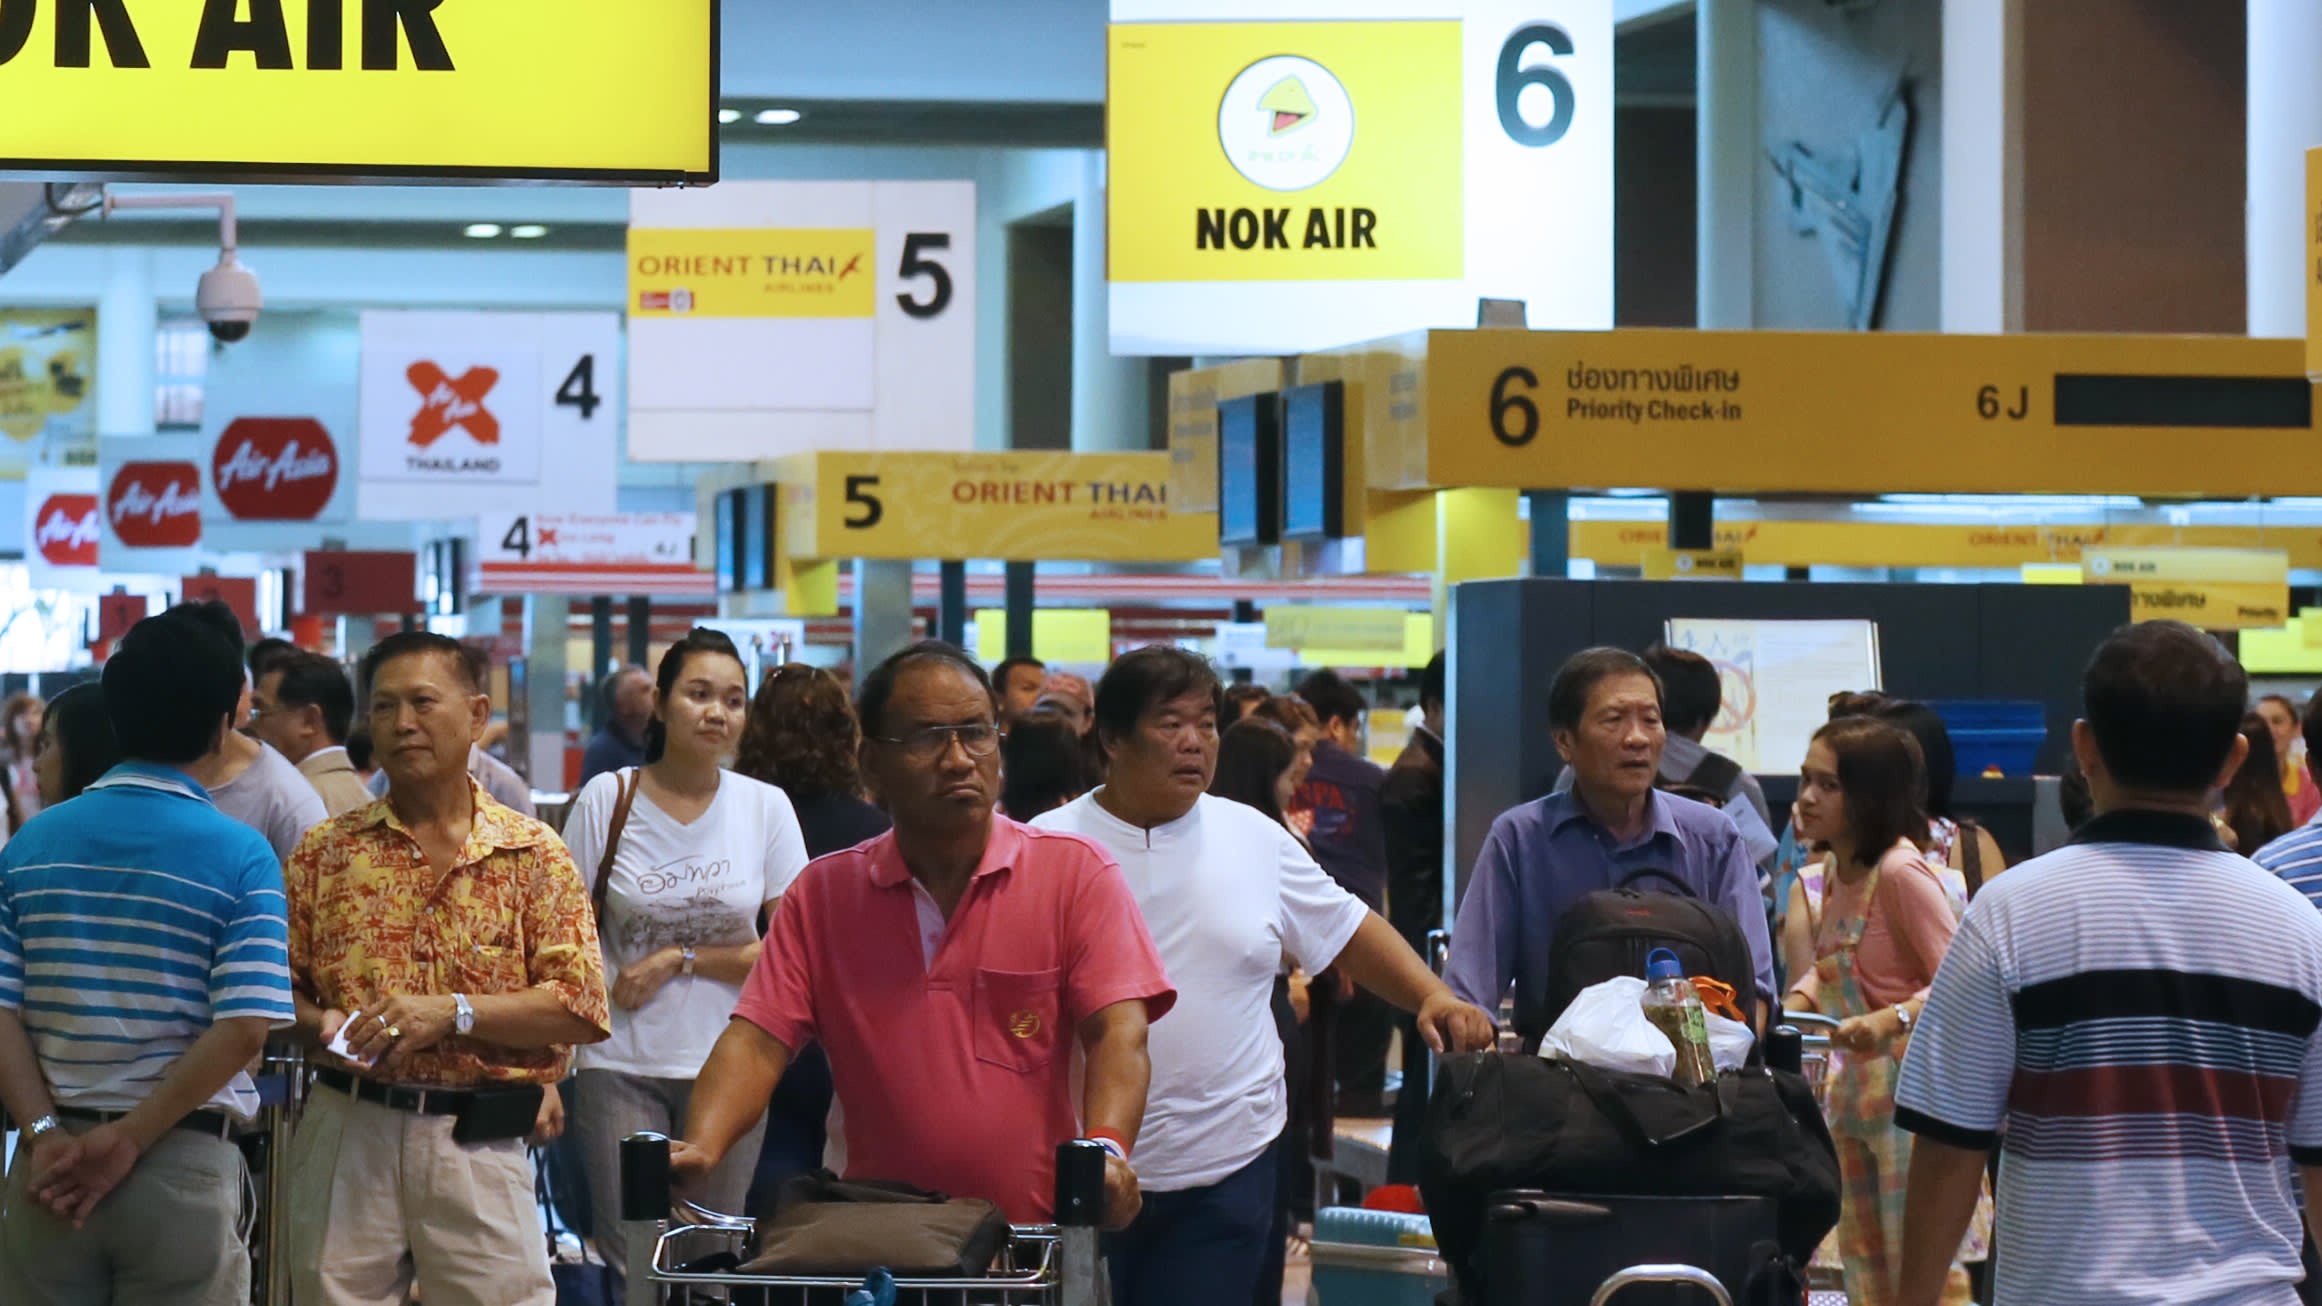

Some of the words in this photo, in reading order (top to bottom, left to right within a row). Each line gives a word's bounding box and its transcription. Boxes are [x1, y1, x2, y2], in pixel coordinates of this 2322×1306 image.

[1495, 22, 1575, 148] 6
[1196, 208, 1290, 249] NOK
[1302, 208, 1377, 249] AIR
[638, 256, 751, 276] ORIENT
[762, 256, 835, 276] THAI
[895, 233, 952, 319] 5
[555, 354, 601, 420] 4
[1567, 361, 1740, 391] ช่องทางพิเศษ
[1489, 366, 1539, 447] 6
[1567, 398, 1642, 424] Priority
[1647, 399, 1741, 420] Check-in
[406, 457, 499, 473] THAILAND
[843, 475, 884, 529] 5
[951, 481, 1077, 505] ORIENT
[1086, 482, 1167, 504] THAI
[502, 516, 531, 558] 4
